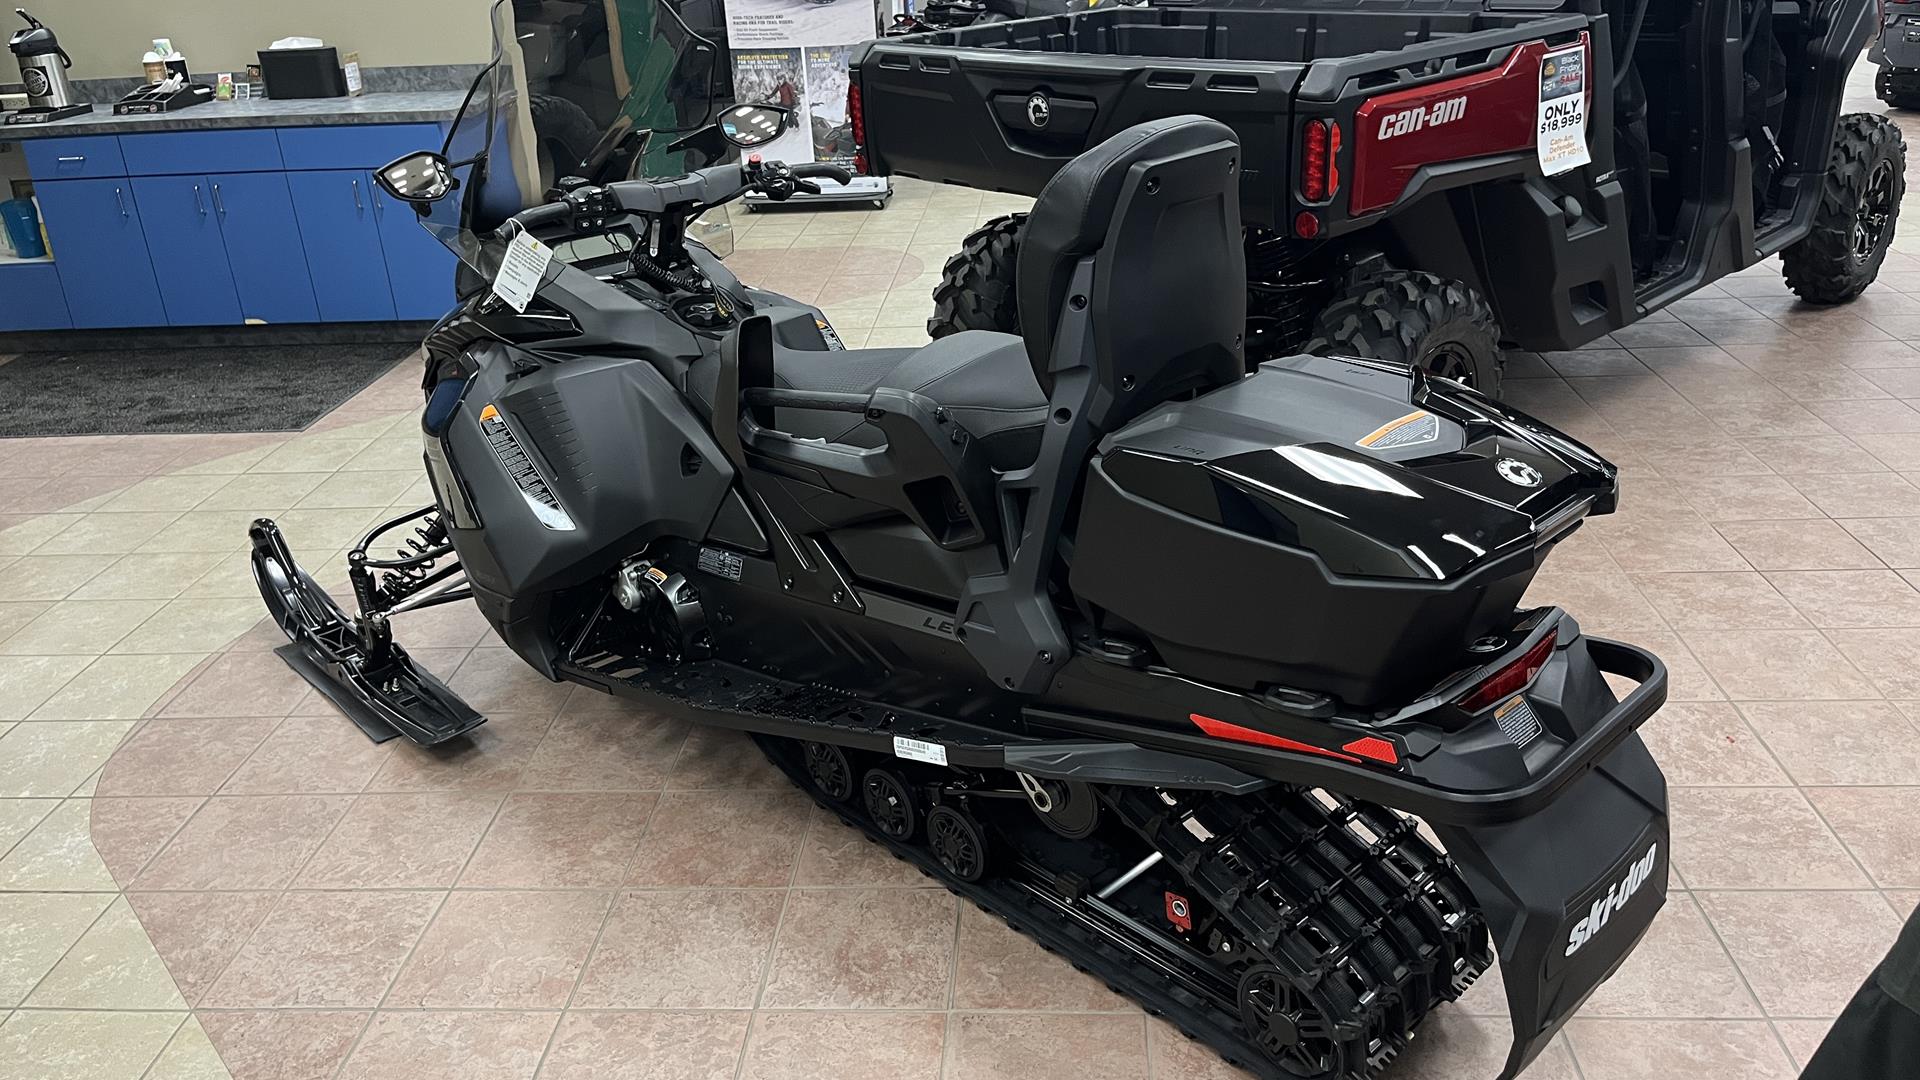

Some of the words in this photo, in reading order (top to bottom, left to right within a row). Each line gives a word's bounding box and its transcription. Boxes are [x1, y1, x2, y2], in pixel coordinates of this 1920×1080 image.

[1561, 54, 1580, 64] Black
[1560, 63, 1581, 74] Friday
[1560, 72, 1581, 84] SALE
[1544, 99, 1580, 120] ONLY
[1540, 112, 1582, 134] $18,999
